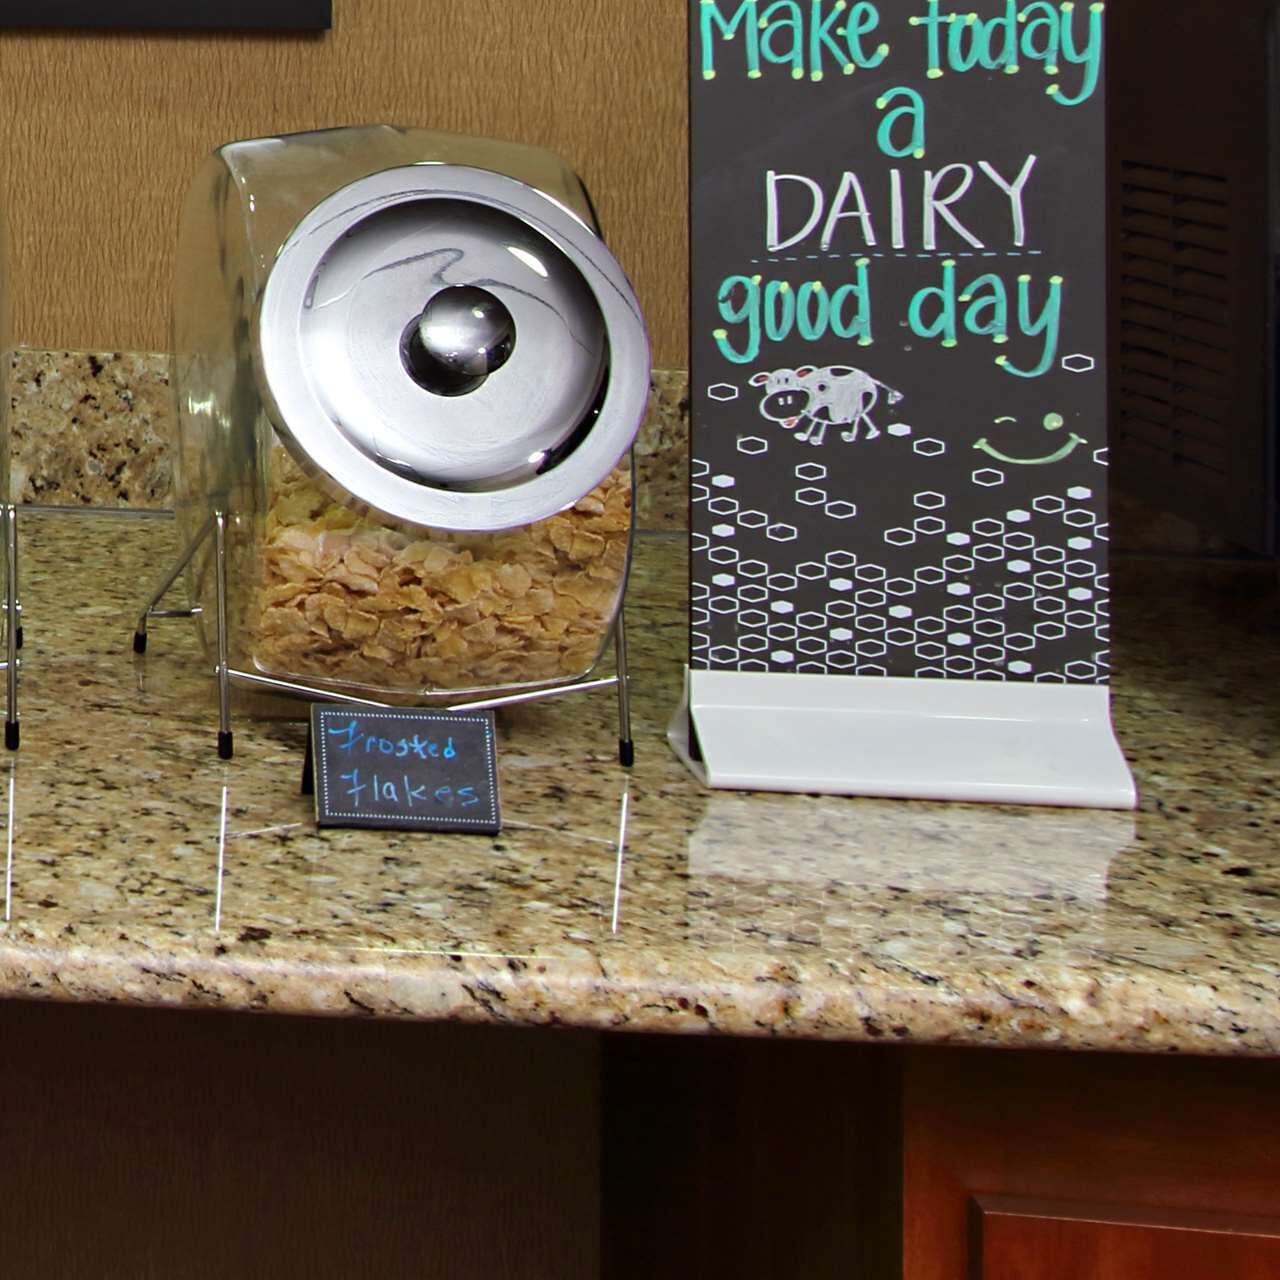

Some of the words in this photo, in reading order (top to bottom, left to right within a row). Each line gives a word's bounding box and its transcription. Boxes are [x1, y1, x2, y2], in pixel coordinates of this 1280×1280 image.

[876, 86, 926, 159] a
[765, 153, 1038, 252] DAIRY
[712, 257, 874, 364] good
[907, 257, 1063, 378] day
[327, 719, 458, 760] Frosted
[340, 767, 481, 808] Flakes
